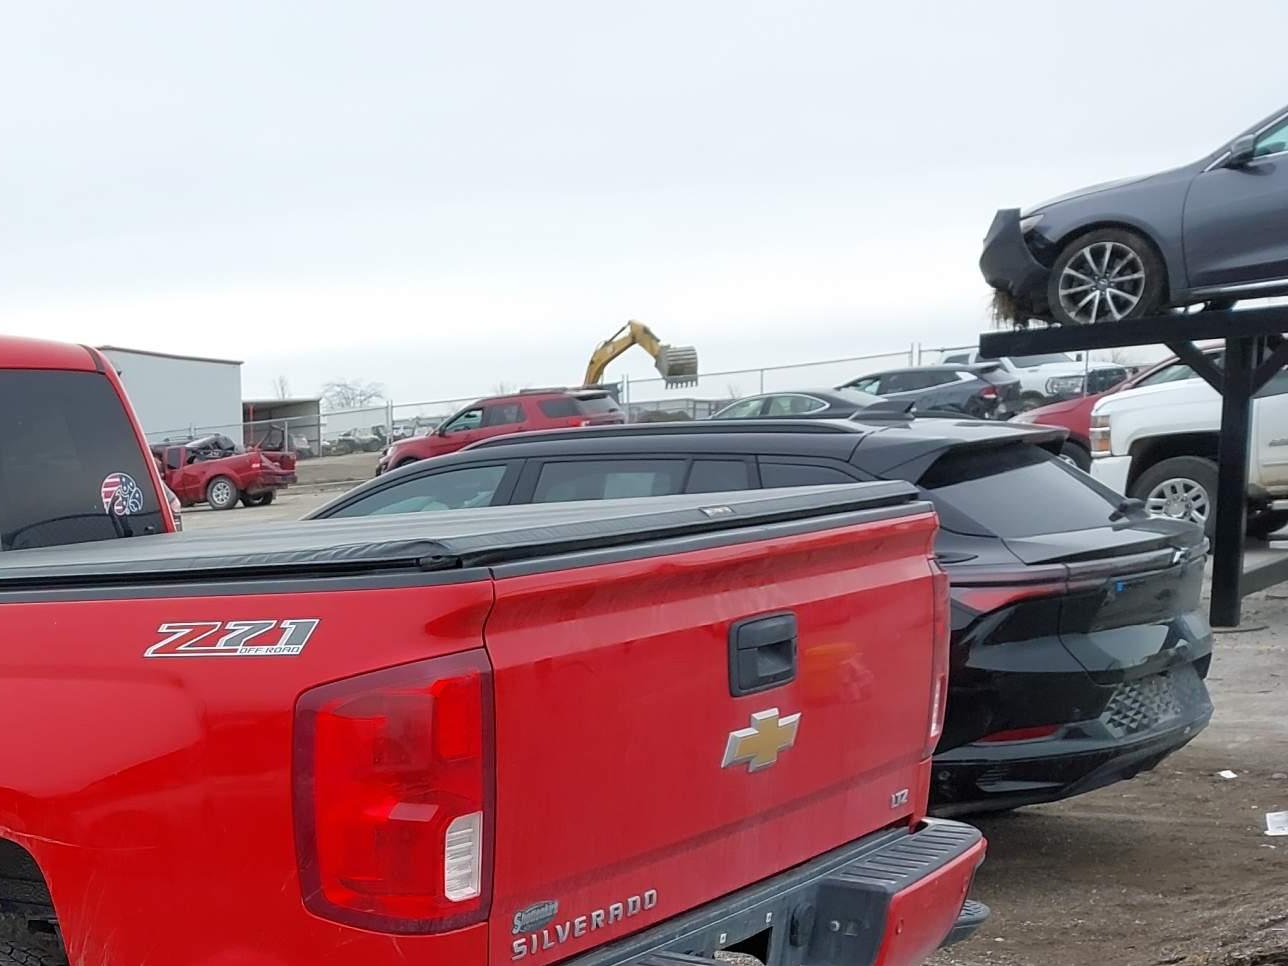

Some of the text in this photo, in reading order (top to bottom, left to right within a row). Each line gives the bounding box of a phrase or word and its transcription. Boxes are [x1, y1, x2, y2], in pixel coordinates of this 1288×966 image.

[143, 618, 321, 658] Z71
[890, 788, 909, 808] LTZ
[511, 888, 658, 961] SILVERADO
